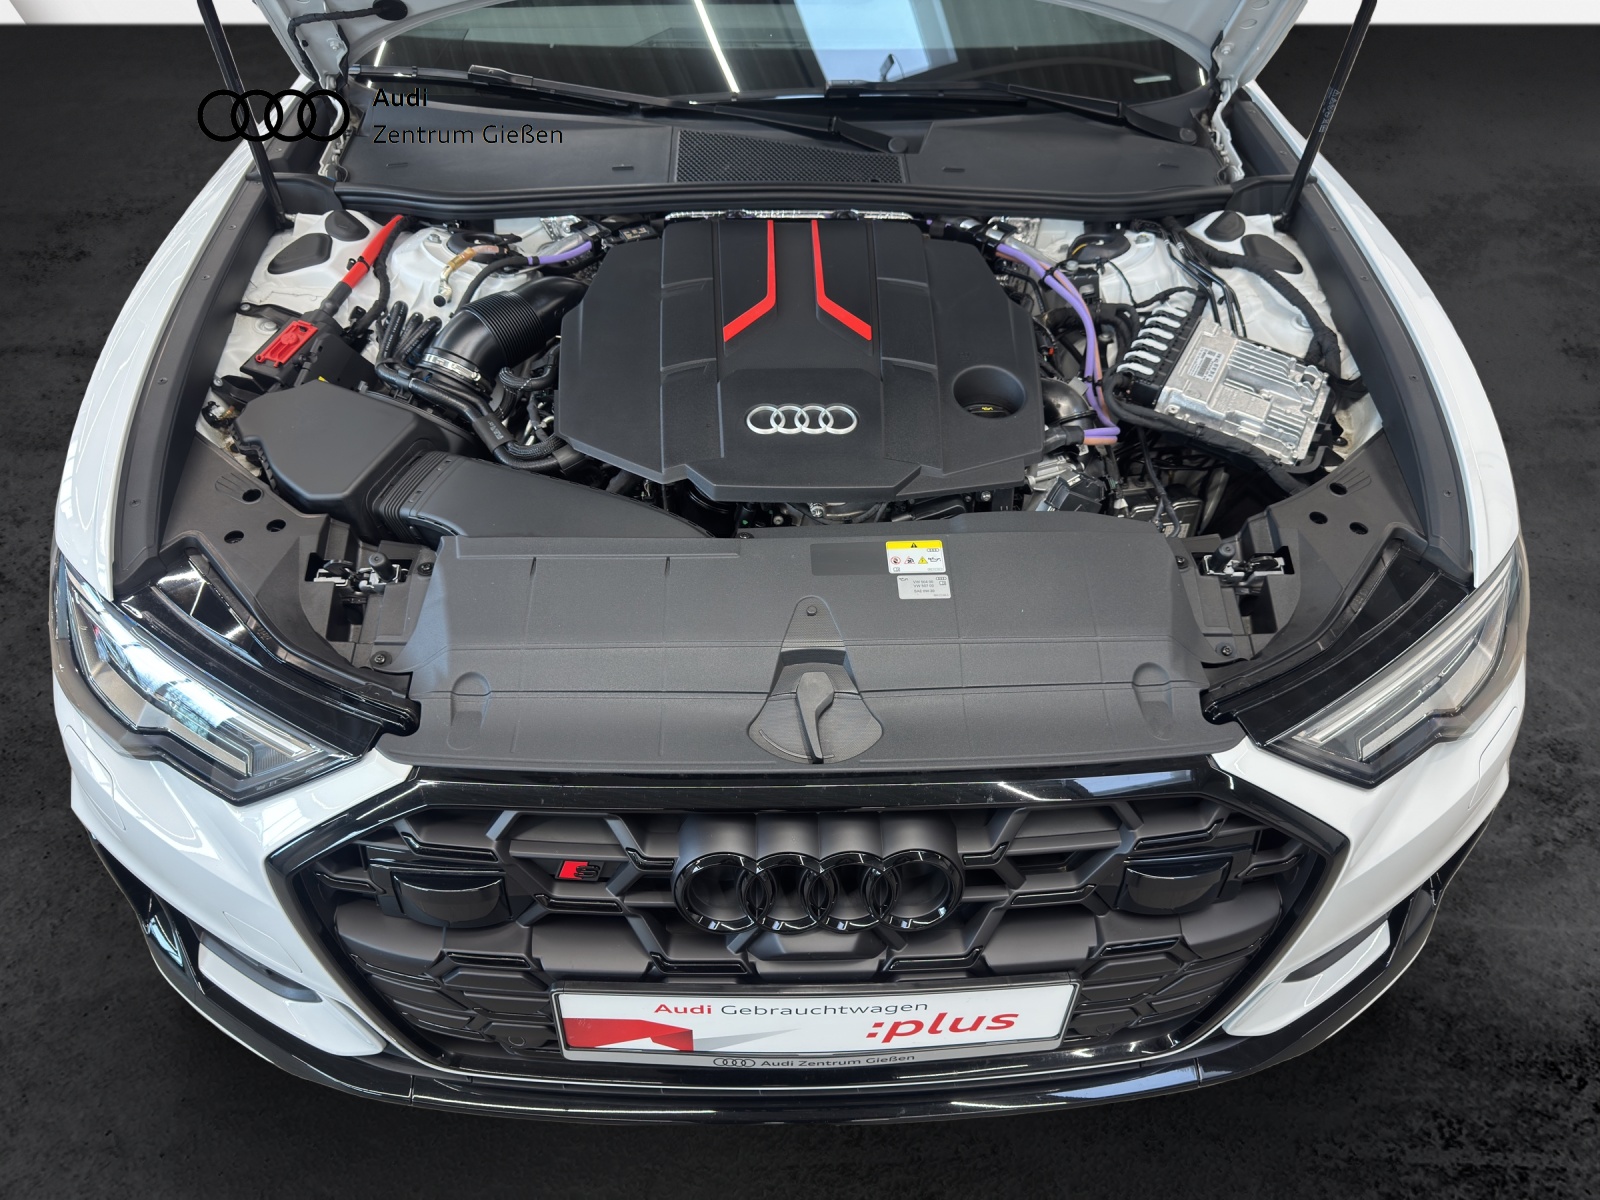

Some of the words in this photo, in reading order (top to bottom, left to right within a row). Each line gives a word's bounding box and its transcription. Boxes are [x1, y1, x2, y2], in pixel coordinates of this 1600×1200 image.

[654, 1004, 712, 1014] Audi
[721, 1003, 928, 1016] Gebrauchtwagen
[798, 1059, 861, 1067] Zentrum
[866, 1055, 915, 1064] Gießen
